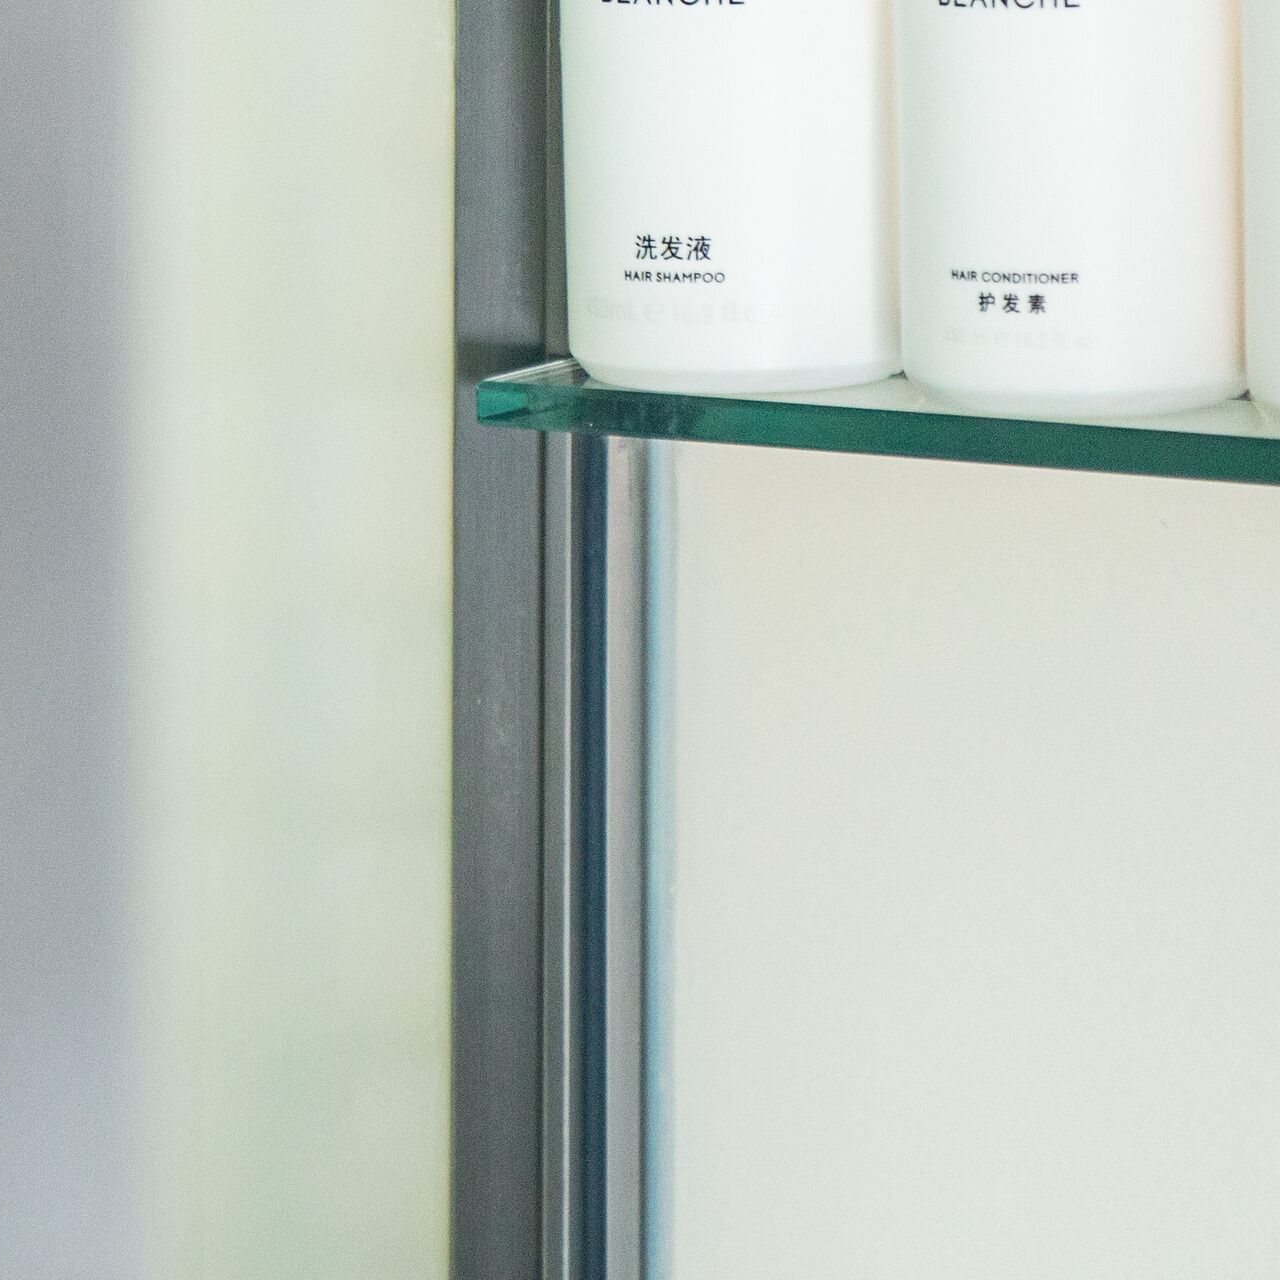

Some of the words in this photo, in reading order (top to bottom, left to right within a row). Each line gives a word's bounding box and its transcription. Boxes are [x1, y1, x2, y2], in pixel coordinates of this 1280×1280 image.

[635, 234, 712, 261] 洗发液
[623, 270, 652, 282] HAIR
[656, 272, 726, 284] SHAMPOO
[951, 269, 977, 282] HAIR
[981, 271, 1079, 285] CONDITIONER
[978, 292, 1046, 314] 护发素
